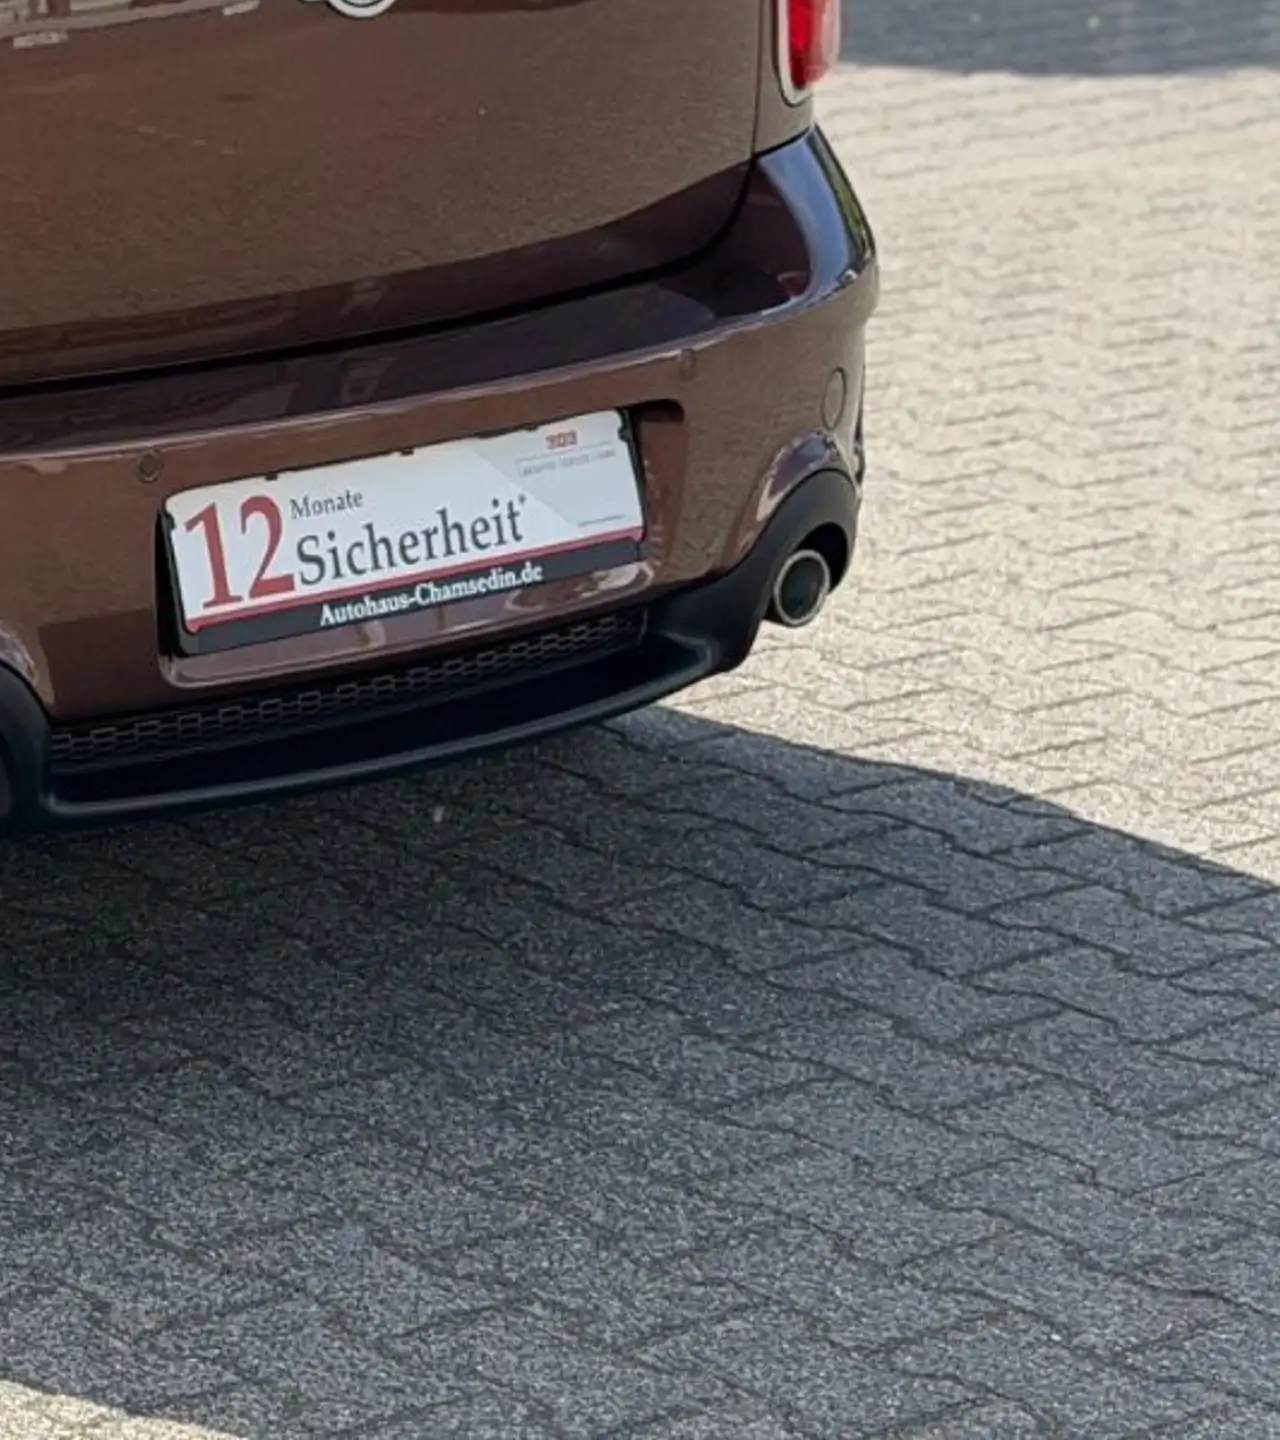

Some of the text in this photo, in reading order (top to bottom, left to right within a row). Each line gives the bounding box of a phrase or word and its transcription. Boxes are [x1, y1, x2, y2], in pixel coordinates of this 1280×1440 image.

[290, 489, 364, 520] Monate
[184, 494, 296, 609] 12
[319, 561, 544, 627] Autohaus-Chamsedin.de
